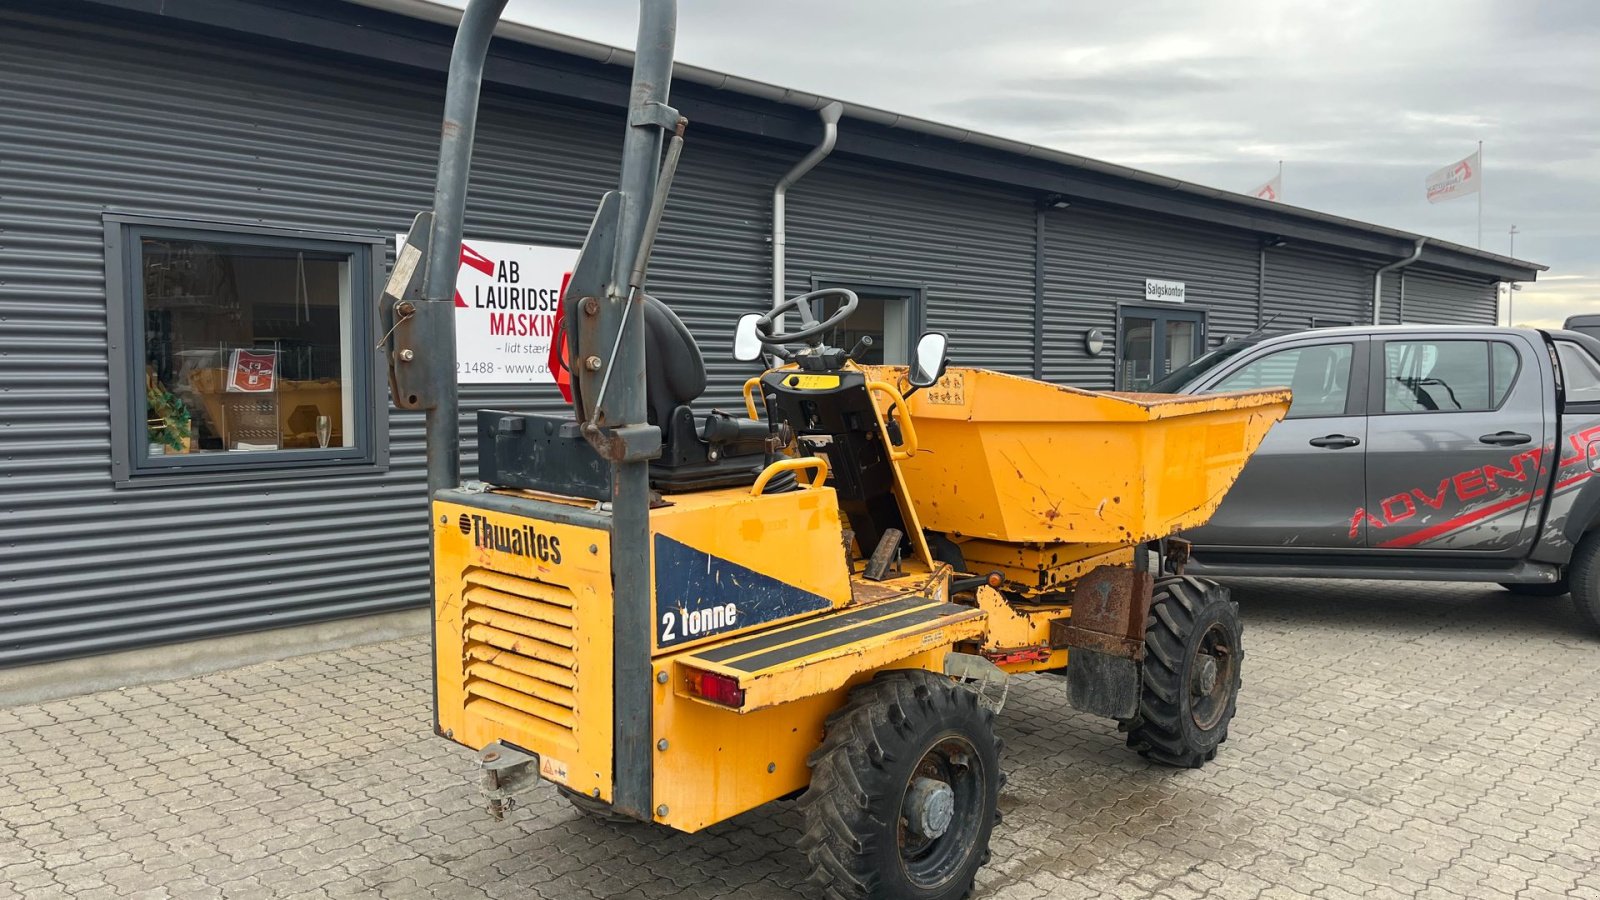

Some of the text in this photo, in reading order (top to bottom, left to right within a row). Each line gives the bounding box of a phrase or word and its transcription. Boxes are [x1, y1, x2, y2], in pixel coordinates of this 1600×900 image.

[497, 260, 520, 283] AB
[1147, 282, 1184, 298] Salgskontor
[504, 342, 521, 354] lidt
[465, 362, 494, 374] 1488
[471, 513, 562, 566] Thwaites
[661, 601, 738, 642] 2 tonne
